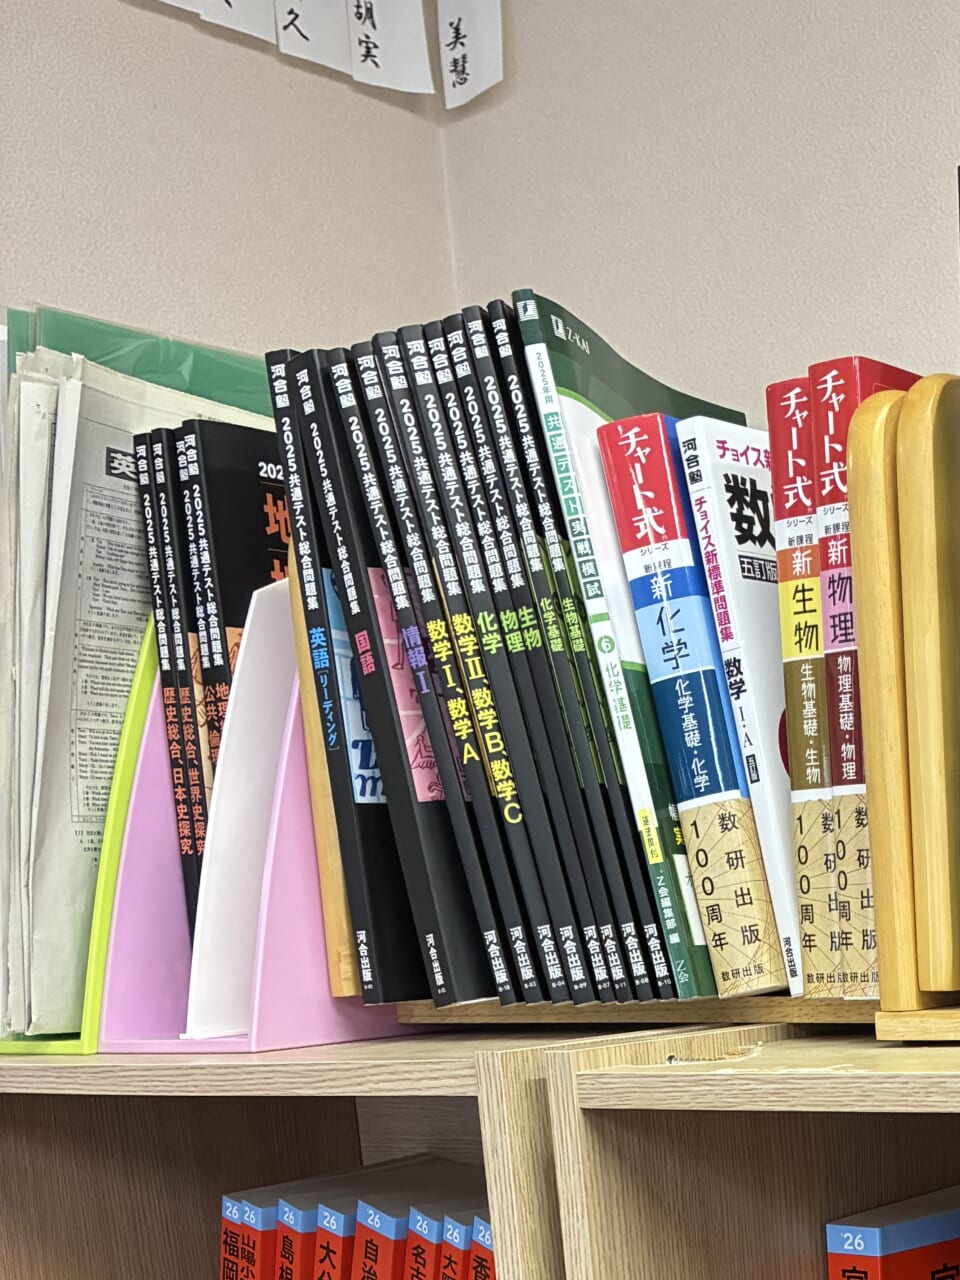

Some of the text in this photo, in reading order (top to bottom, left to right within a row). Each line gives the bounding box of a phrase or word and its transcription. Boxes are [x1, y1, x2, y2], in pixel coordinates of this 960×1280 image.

[282, 8, 310, 41] 久
[445, 18, 468, 87] 美慧
[566, 326, 591, 355] Z-KAI
[270, 363, 290, 409] 河合塾
[682, 437, 703, 485] 河合塾
[779, 386, 813, 512] チャート式
[816, 369, 848, 497] チャート式
[406, 340, 503, 655] 河合塾 化学
[618, 425, 666, 540] チャート式
[786, 517, 813, 528] シリーズ
[787, 533, 814, 547] 新課程
[791, 550, 813, 577] 新
[500, 609, 526, 653] 物理
[517, 606, 543, 650] 生物
[540, 597, 565, 653] 化学基礎
[792, 584, 820, 653] 生物
[828, 572, 855, 645] 物理
[354, 629, 376, 676] 国語
[491, 318, 669, 978] 河合塾 生物基礎 河合出版
[655, 606, 691, 671] 化学
[675, 679, 711, 793] 化学基礎・化学
[800, 663, 822, 784] 生物基礎・生物
[837, 655, 857, 781] 物理基礎・物理
[483, 929, 509, 983] 河合出版
[537, 924, 564, 980] 河合出版
[721, 963, 765, 982] 数研出版
